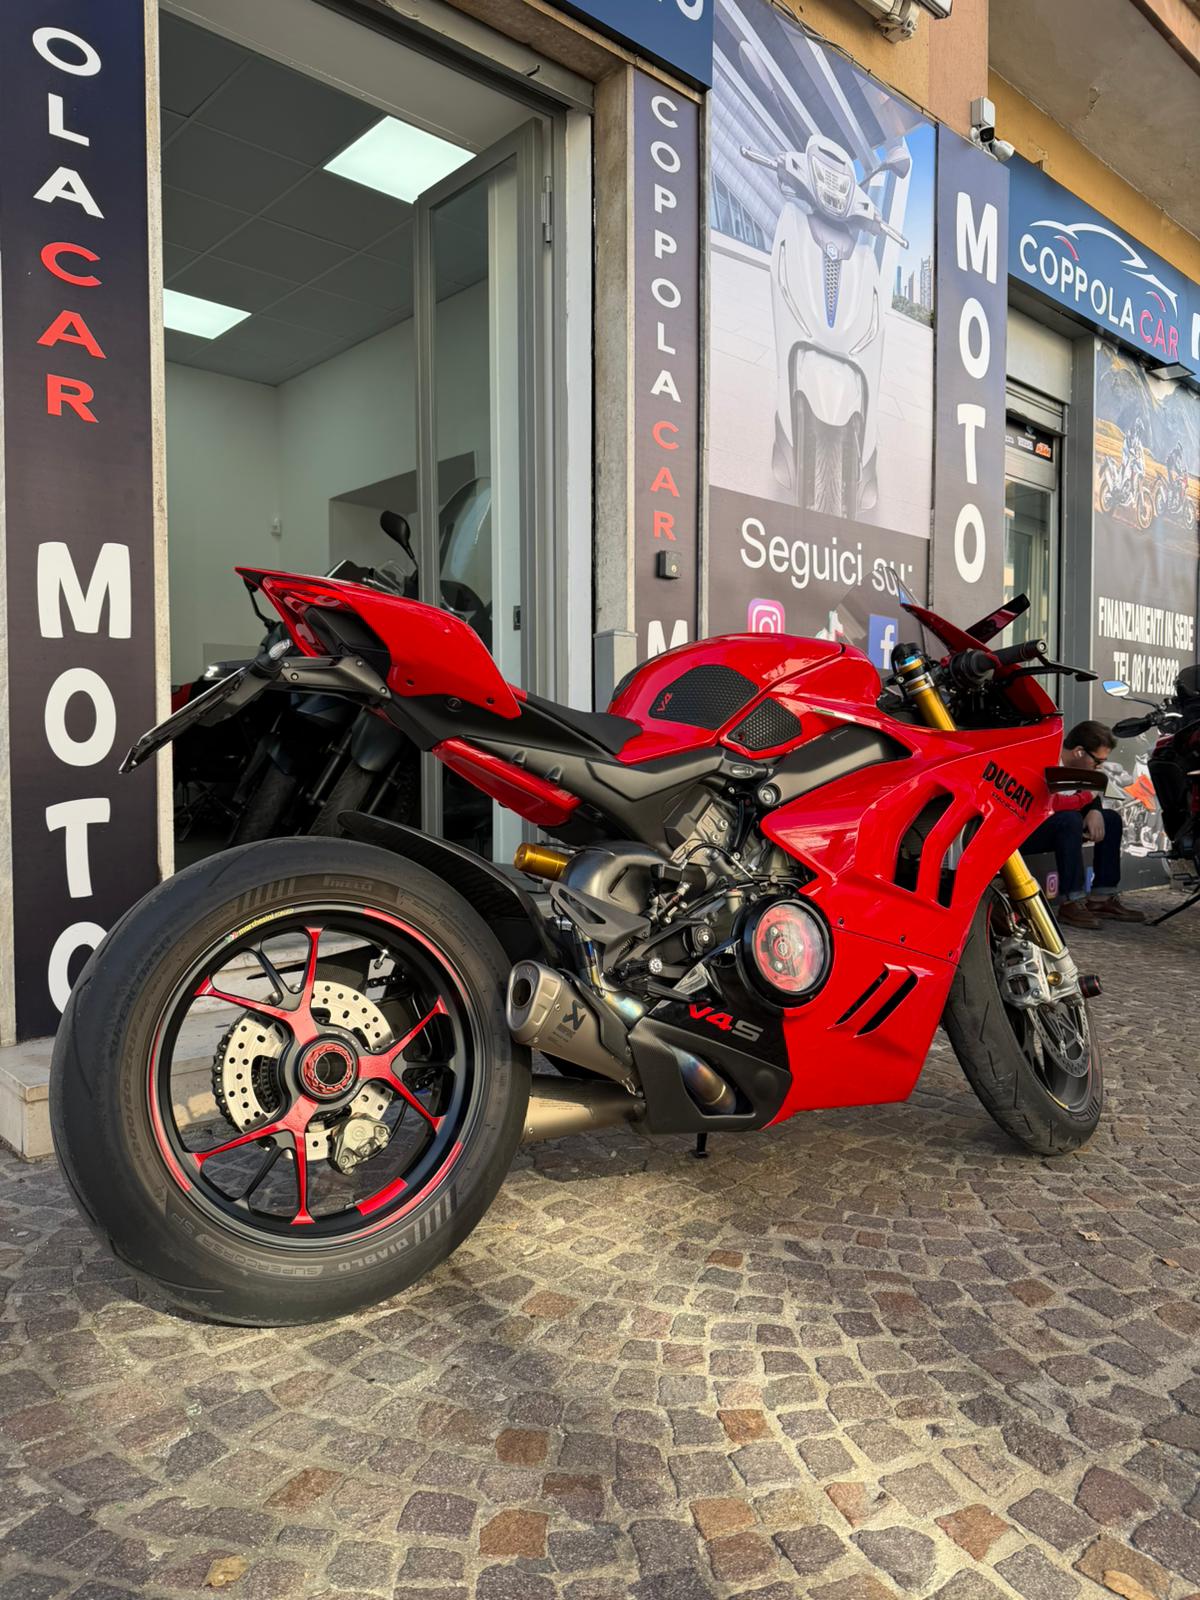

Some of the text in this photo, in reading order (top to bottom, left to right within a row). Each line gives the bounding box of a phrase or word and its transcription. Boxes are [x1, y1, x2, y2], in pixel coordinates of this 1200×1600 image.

[954, 191, 998, 584] MOTO
[740, 517, 863, 590] Seguici
[1098, 596, 1195, 652] FINANZIAMENTI IN SEDE
[981, 759, 1035, 814] DUCATI
[336, 1237, 410, 1273] DIABLO
